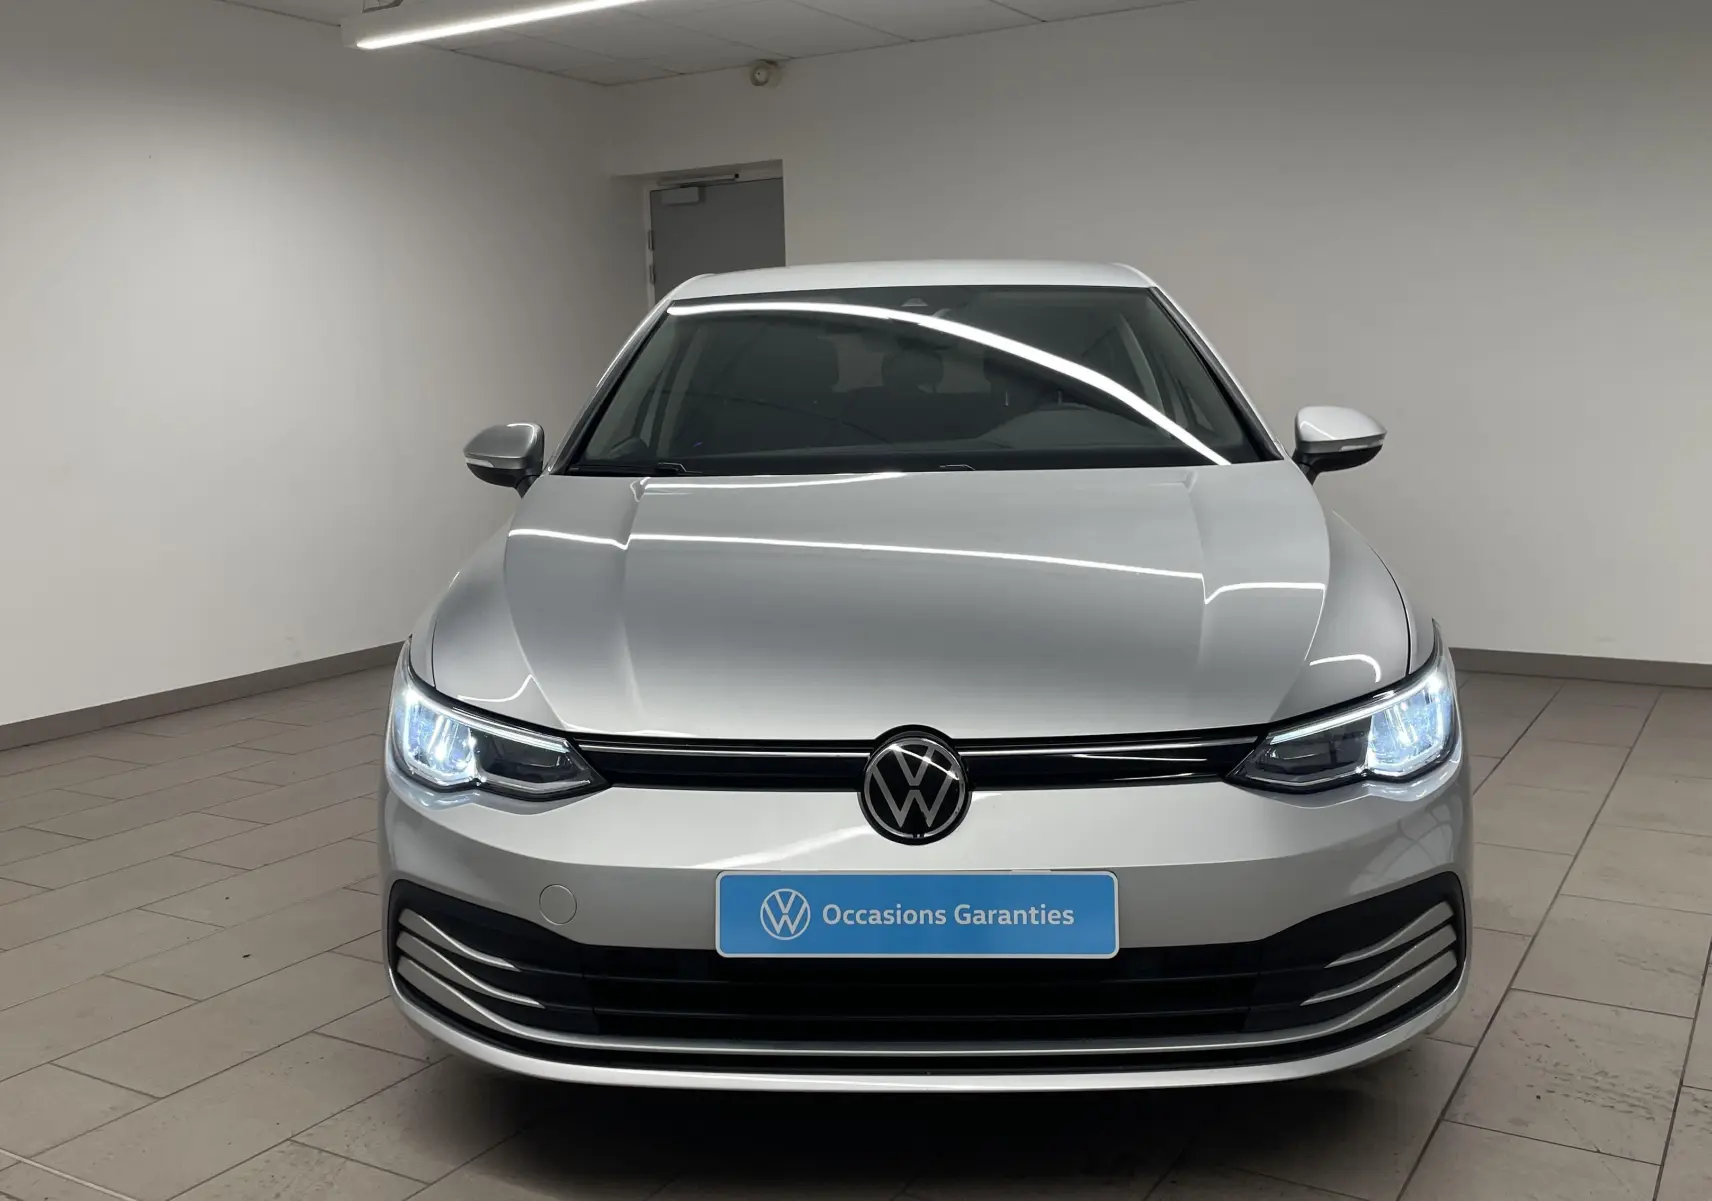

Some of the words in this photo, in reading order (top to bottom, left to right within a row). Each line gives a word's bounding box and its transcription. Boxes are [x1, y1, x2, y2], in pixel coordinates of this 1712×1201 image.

[868, 737, 961, 829] VW
[763, 890, 809, 936] VW
[822, 903, 947, 926] Occasions
[954, 903, 1075, 926] Garanties
